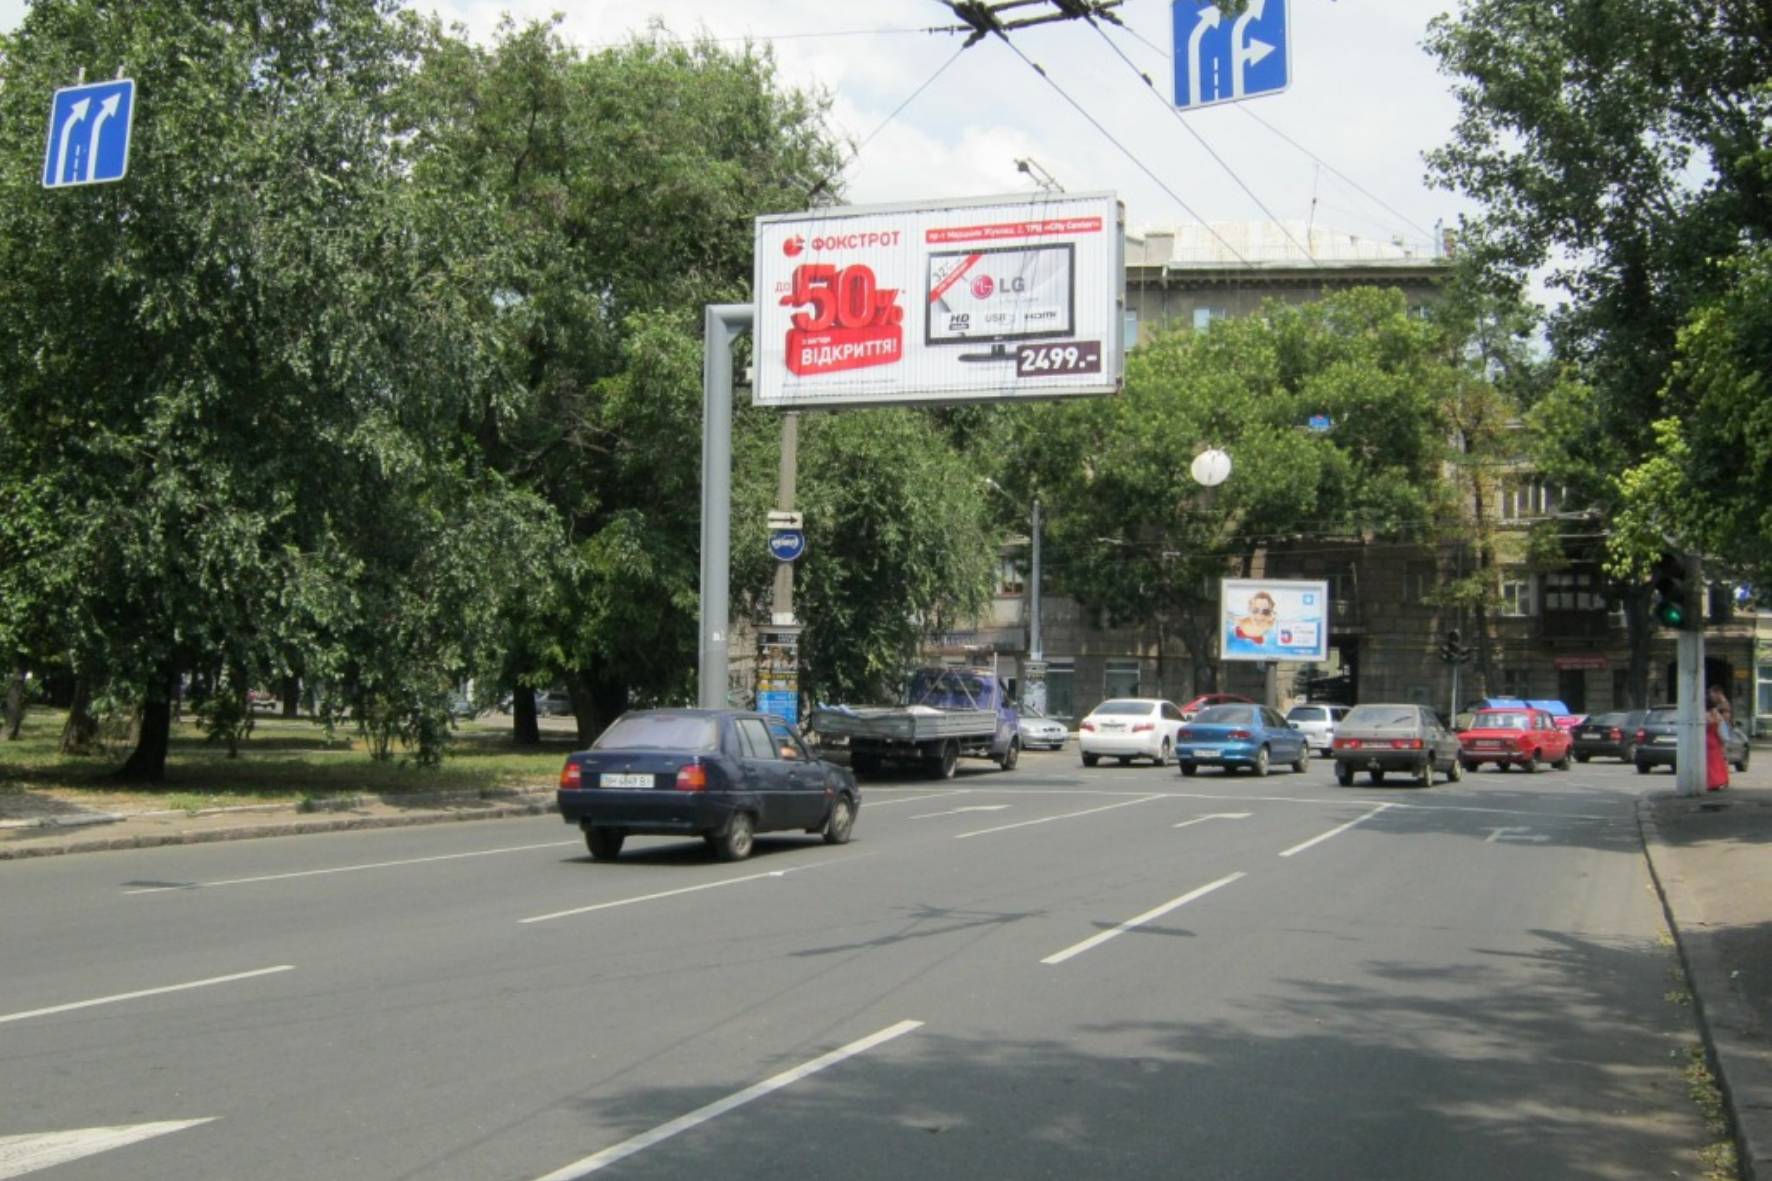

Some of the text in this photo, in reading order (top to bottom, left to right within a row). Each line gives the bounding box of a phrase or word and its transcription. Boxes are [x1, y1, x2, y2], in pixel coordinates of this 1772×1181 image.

[811, 231, 901, 252] ФОКСТРОТ
[999, 277, 1025, 293] LG
[950, 313, 970, 323] HD
[801, 337, 897, 366] ВІДКРИТТЯ!
